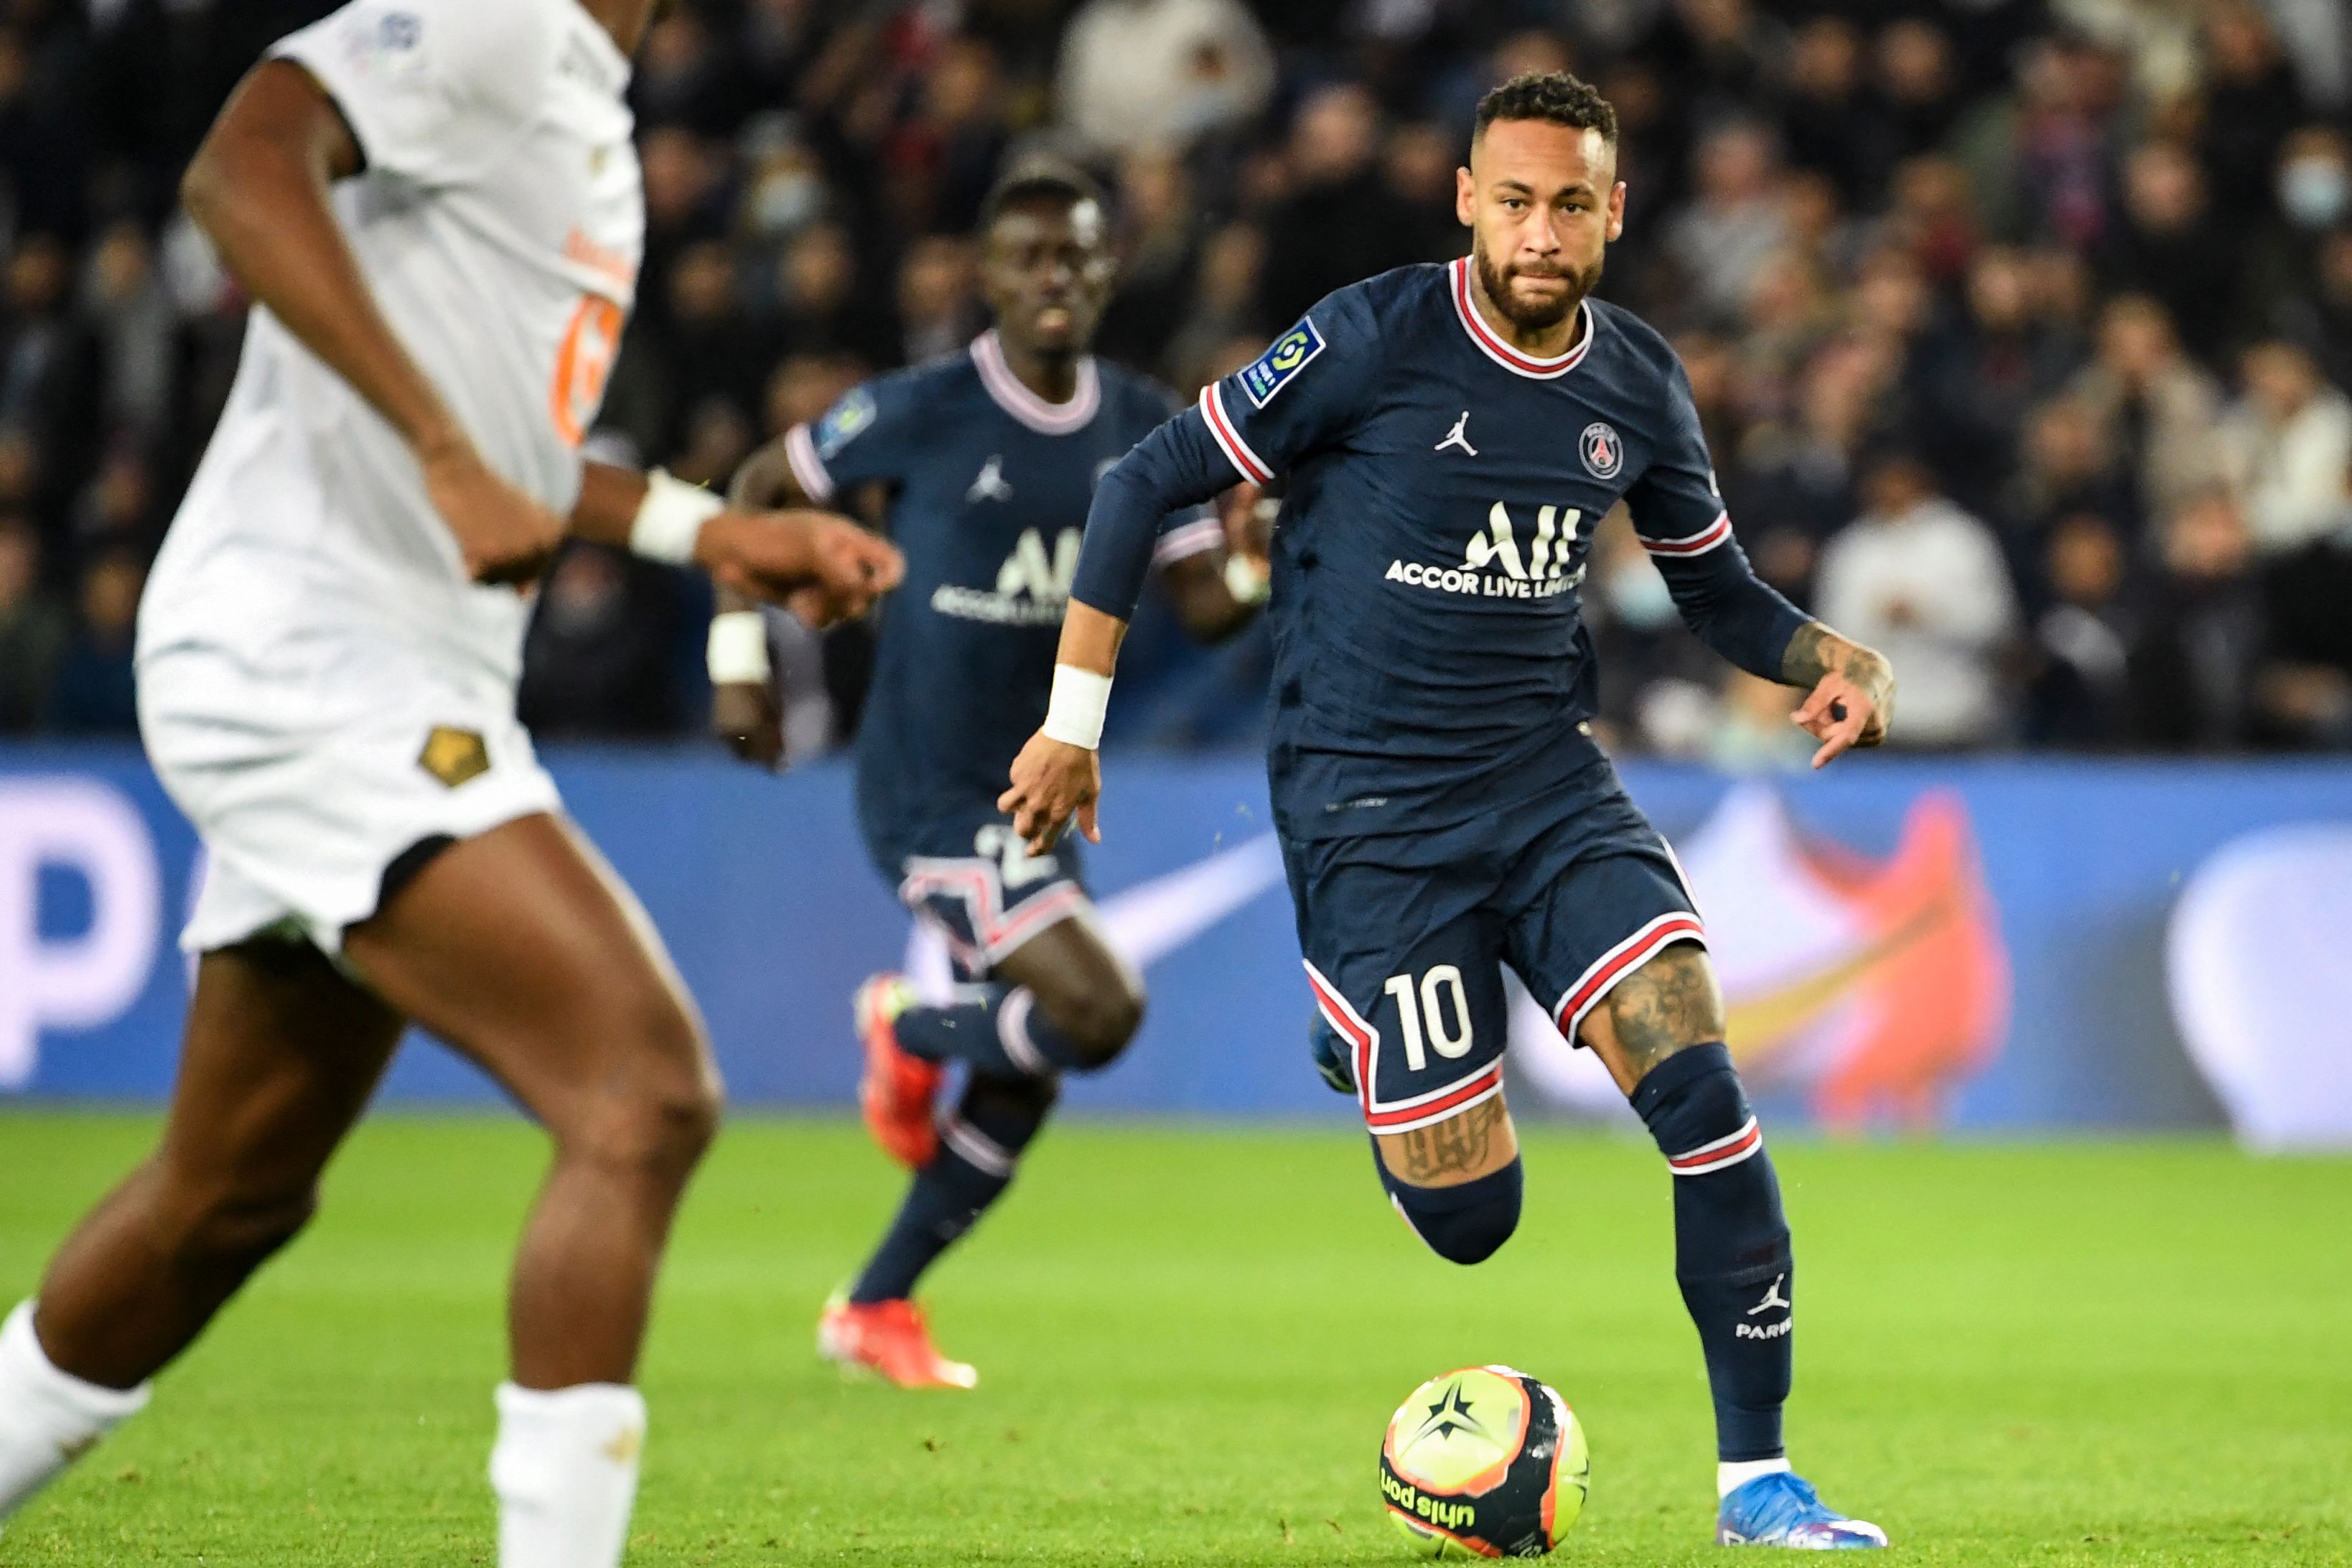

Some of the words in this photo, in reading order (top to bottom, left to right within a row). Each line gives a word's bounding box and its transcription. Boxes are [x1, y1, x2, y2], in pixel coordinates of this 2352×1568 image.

[1385, 559, 1480, 595] ACCOR
[1483, 575, 1531, 598] LIVE
[1384, 964, 1473, 1071] 10
